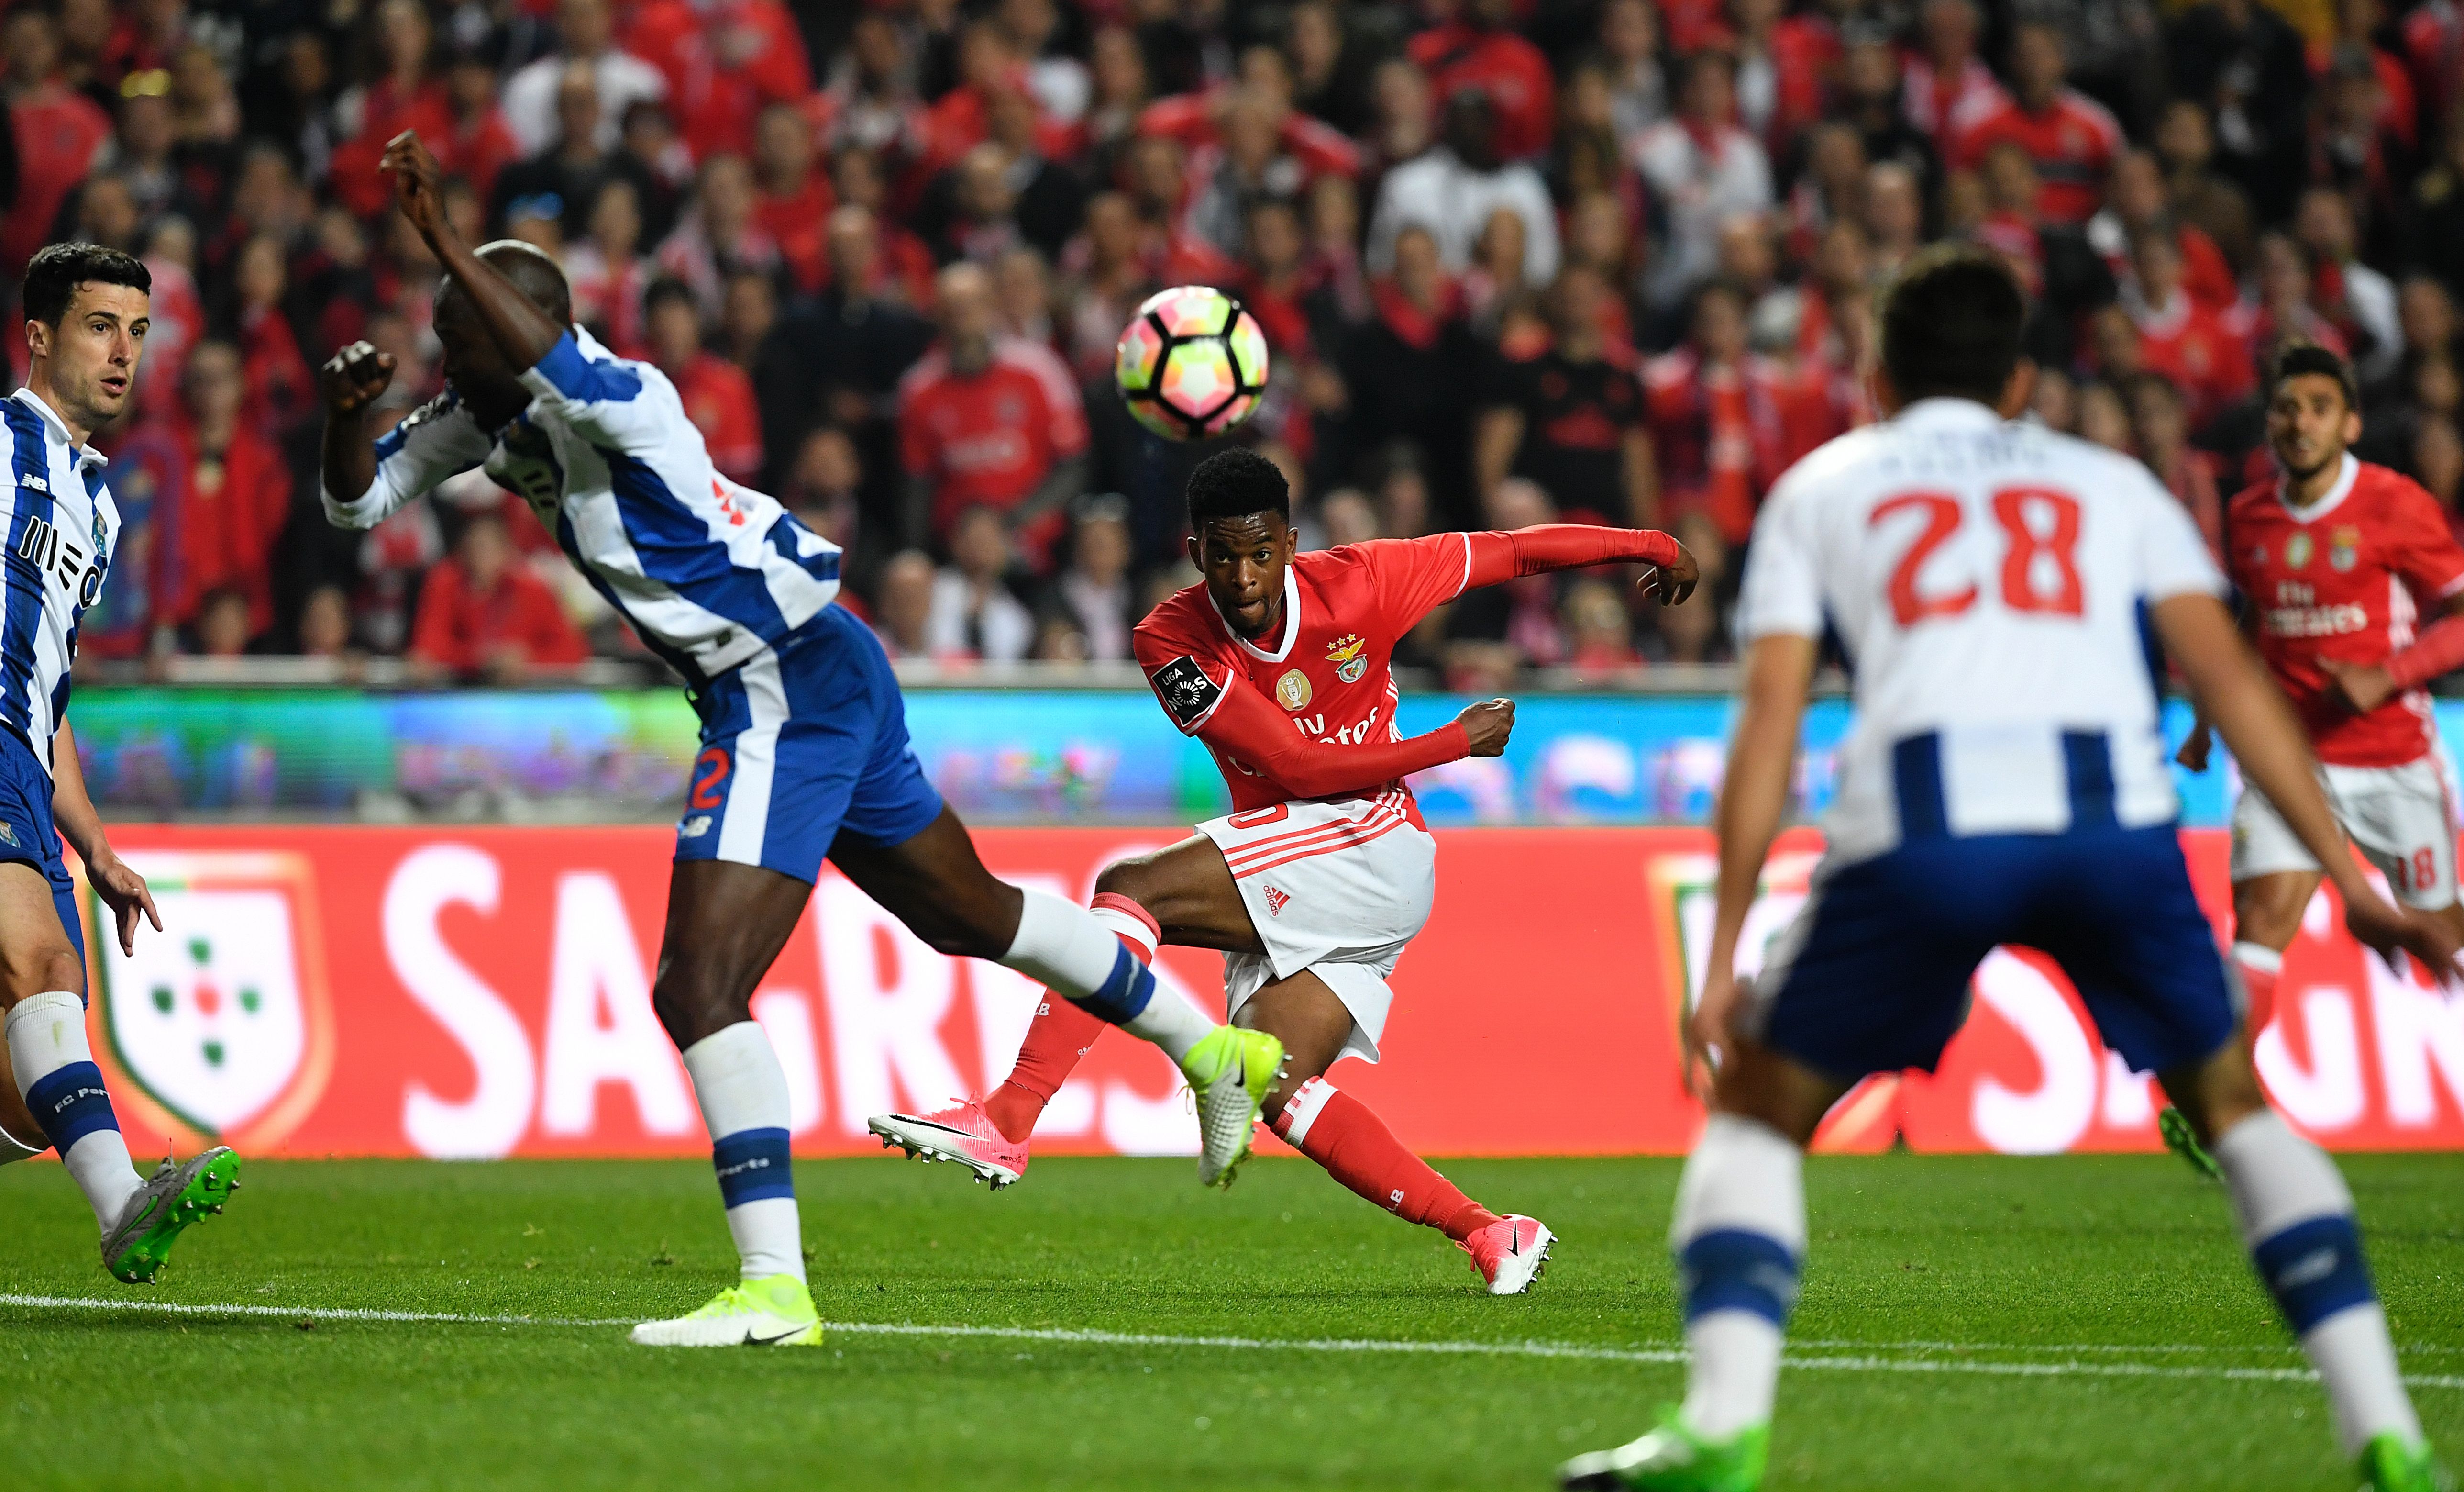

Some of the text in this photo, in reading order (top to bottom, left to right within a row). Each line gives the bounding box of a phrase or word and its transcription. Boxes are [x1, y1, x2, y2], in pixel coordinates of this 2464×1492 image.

[1867, 485, 2087, 632] 28
[1161, 668, 1183, 686] LIGA
[685, 747, 730, 810] 2
[2395, 846, 2436, 891] 18
[1263, 885, 1279, 916] adidas
[55, 1088, 111, 1113] FC Por
